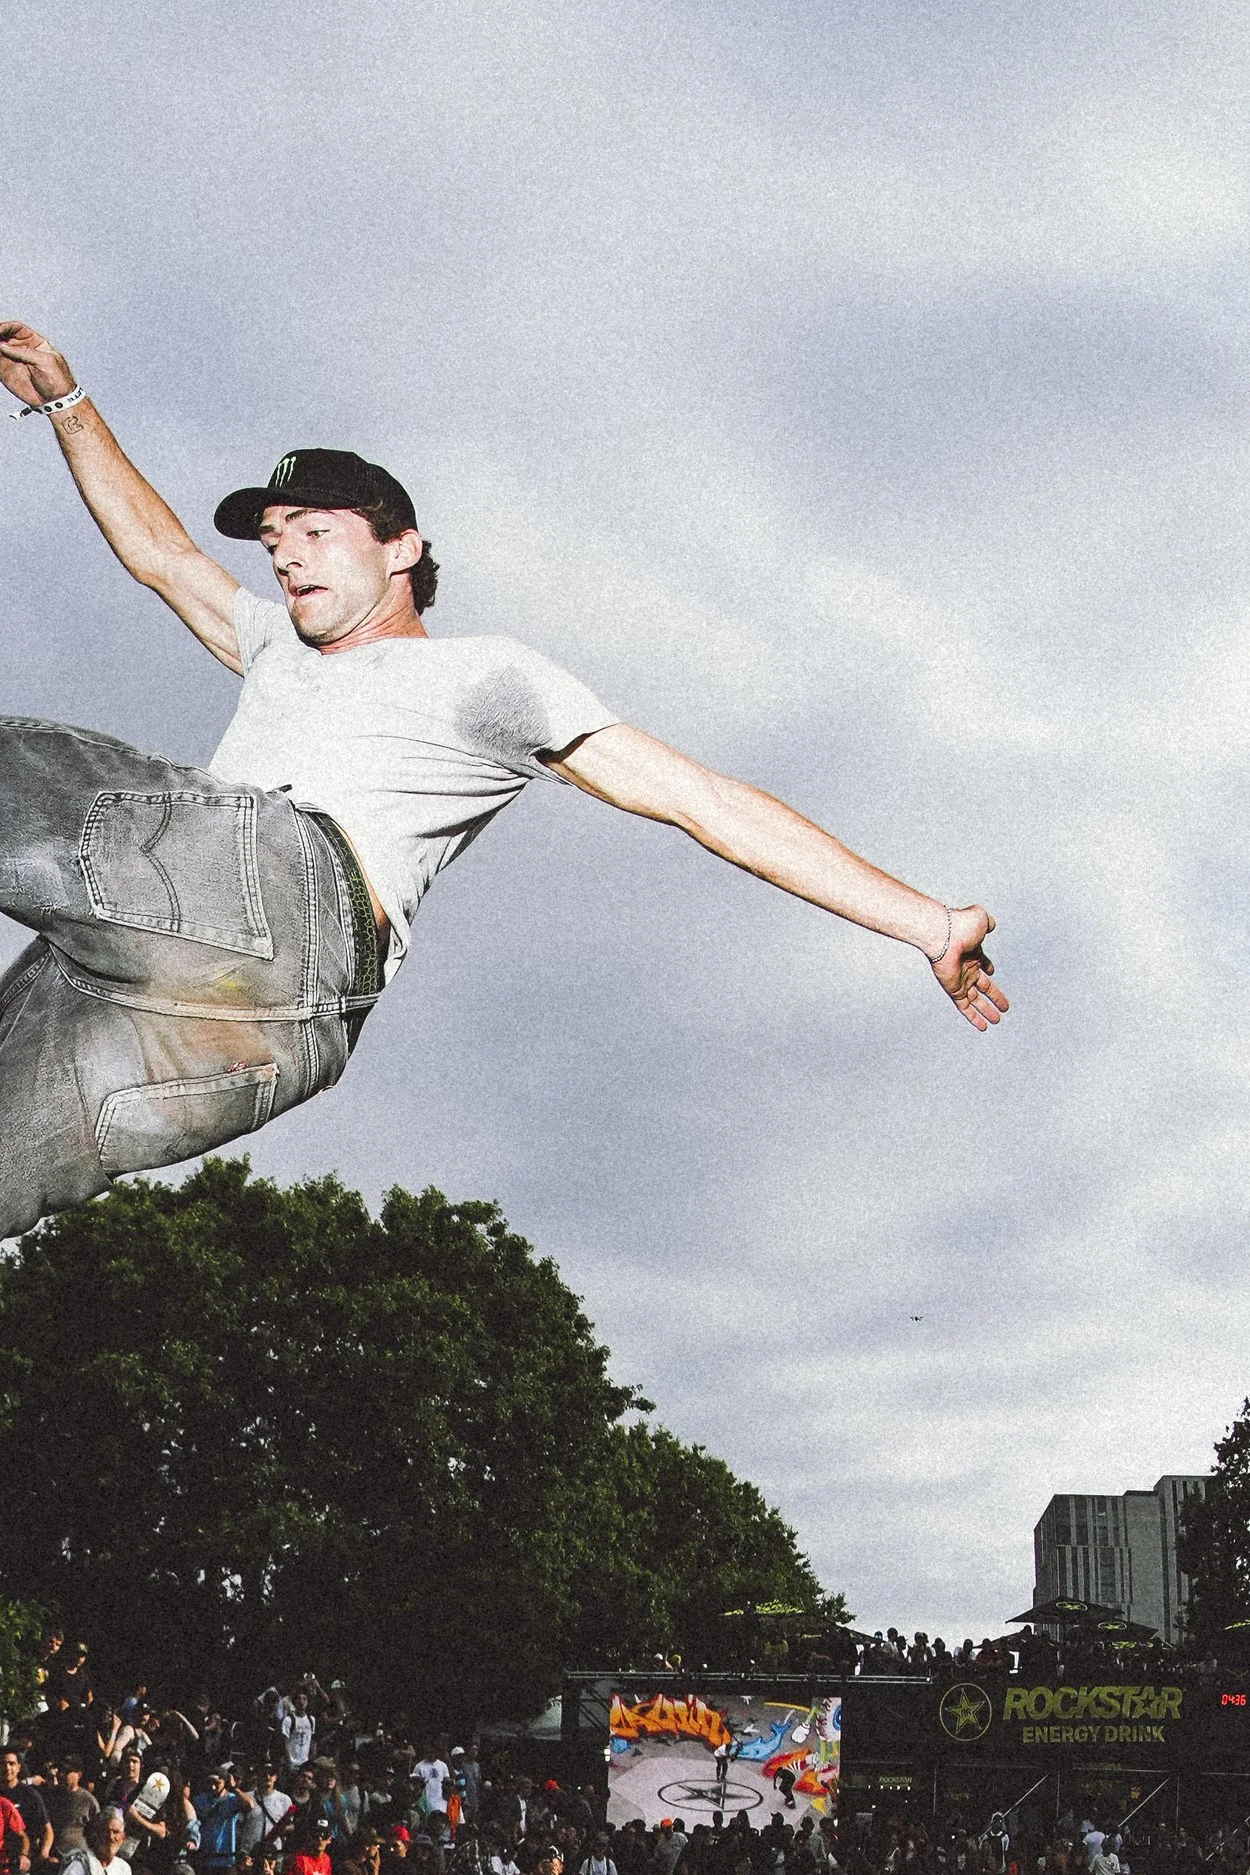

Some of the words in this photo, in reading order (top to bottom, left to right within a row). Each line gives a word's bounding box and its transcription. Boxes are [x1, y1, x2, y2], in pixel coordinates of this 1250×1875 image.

[1003, 1685, 1183, 1720] ROCKSTAR
[1022, 1725, 1100, 1744] ENERGY
[1104, 1725, 1165, 1744] DRINK
